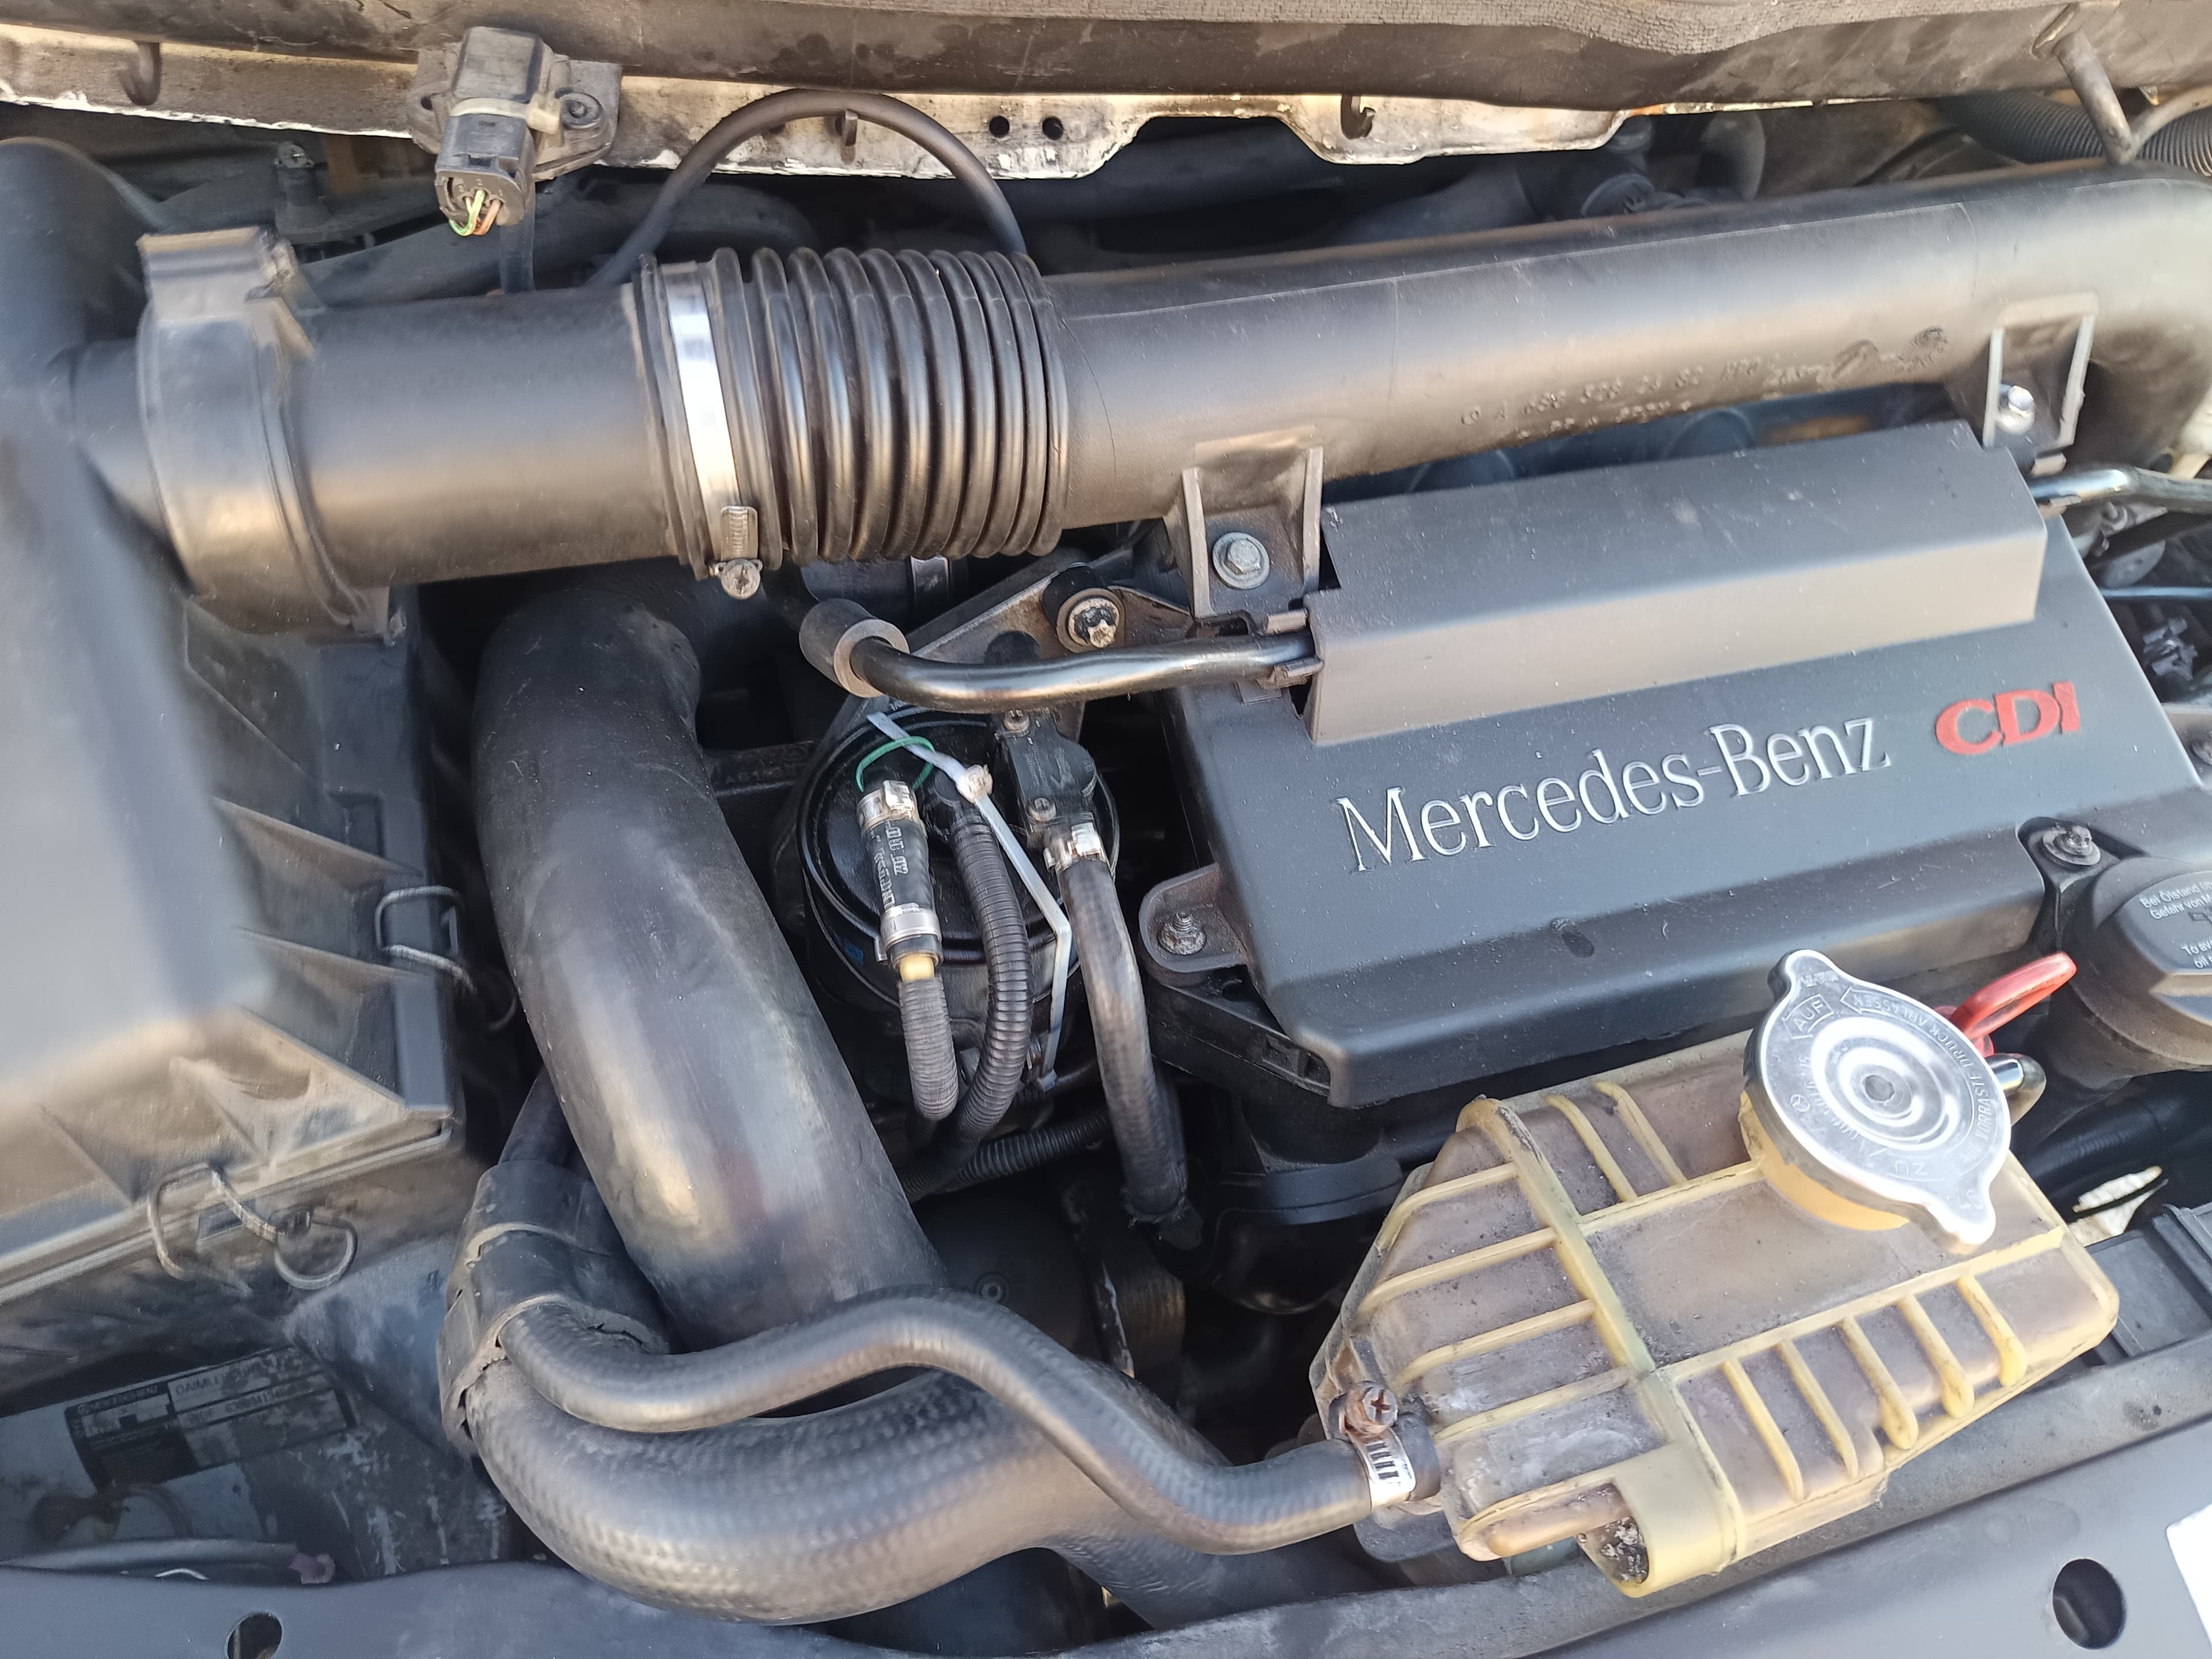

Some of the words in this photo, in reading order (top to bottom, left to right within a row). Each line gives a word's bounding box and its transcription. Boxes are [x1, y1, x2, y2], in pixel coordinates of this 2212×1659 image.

[1935, 681, 2082, 756] CDI
[1336, 717, 1892, 873] Mercedes-Benz
[2149, 903, 2185, 919] Gefahr
[2184, 898, 2205, 908] von
[1793, 998, 1823, 1032] AUF
[1895, 1160, 1929, 1176] ZU
